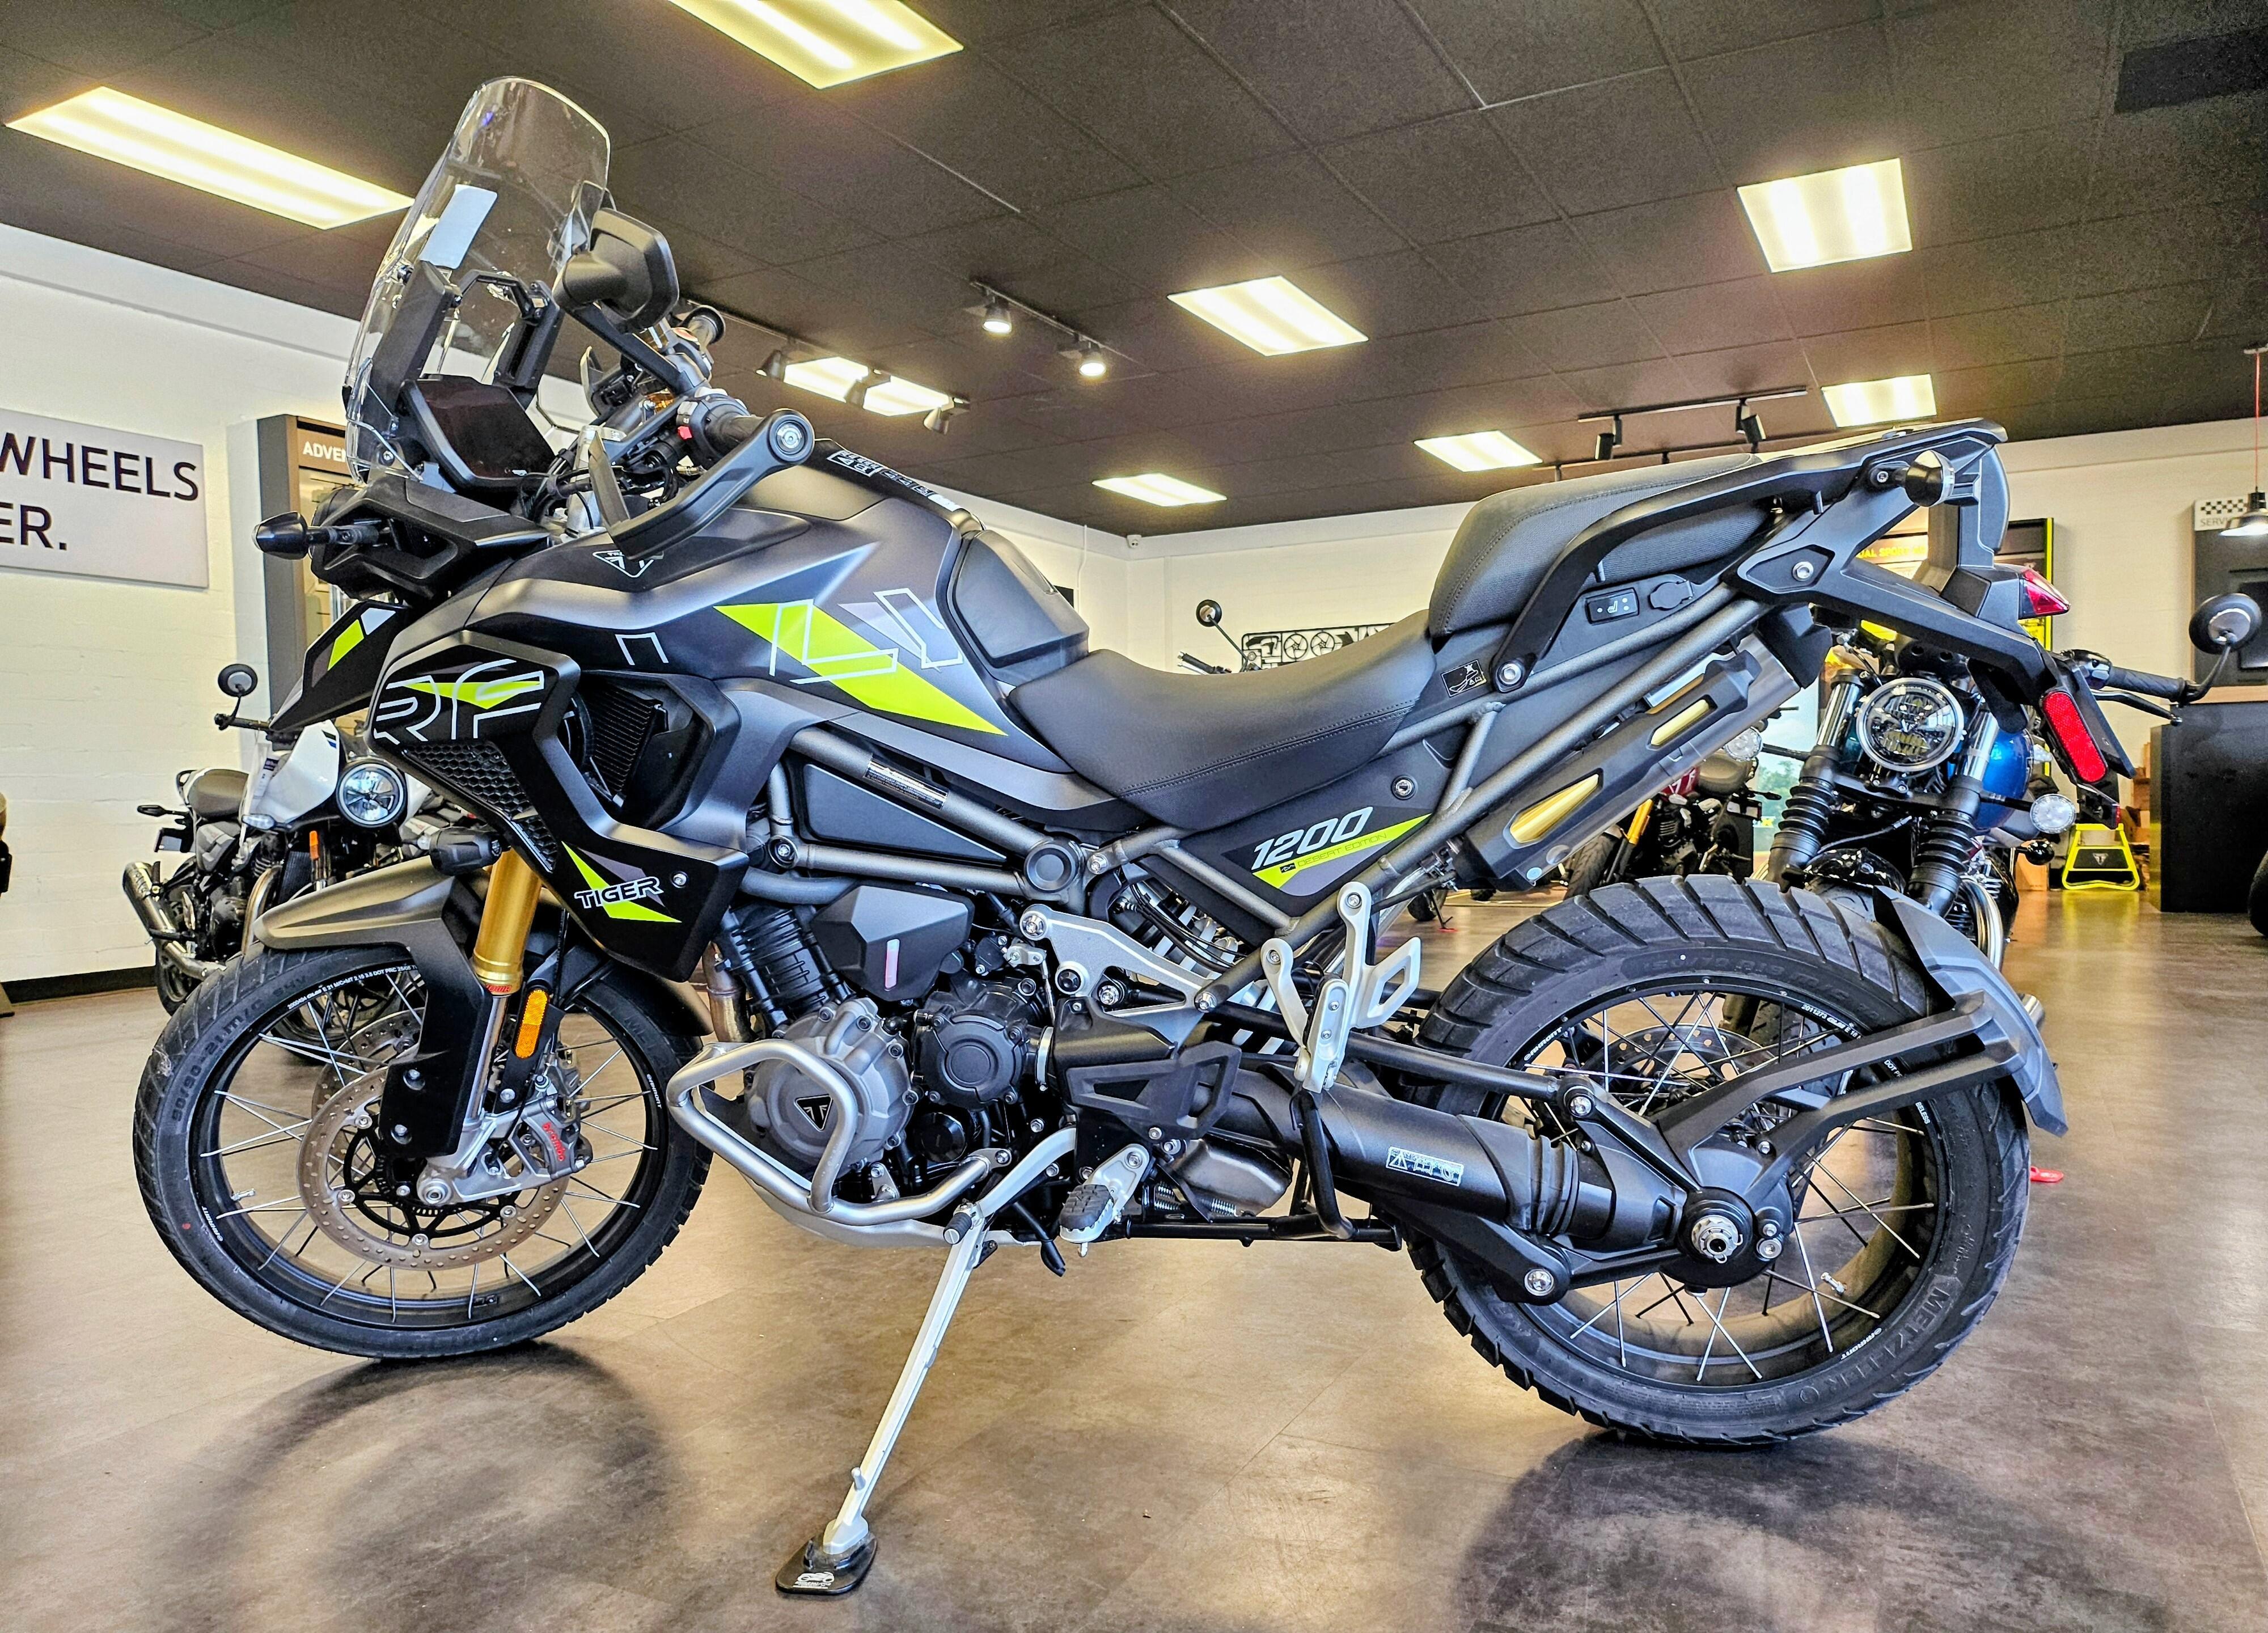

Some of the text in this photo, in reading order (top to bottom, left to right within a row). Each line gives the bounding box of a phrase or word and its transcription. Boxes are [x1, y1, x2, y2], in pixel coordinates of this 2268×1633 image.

[0, 432, 198, 501] WHEELS
[1251, 806, 1373, 870] 1200
[1297, 832, 1387, 867] DESERT EDITION
[574, 876, 664, 909] TIGER
[1850, 1029, 1859, 1039] 18
[1884, 1059, 1898, 1072] DOT
[542, 1122, 566, 1162] brembo
